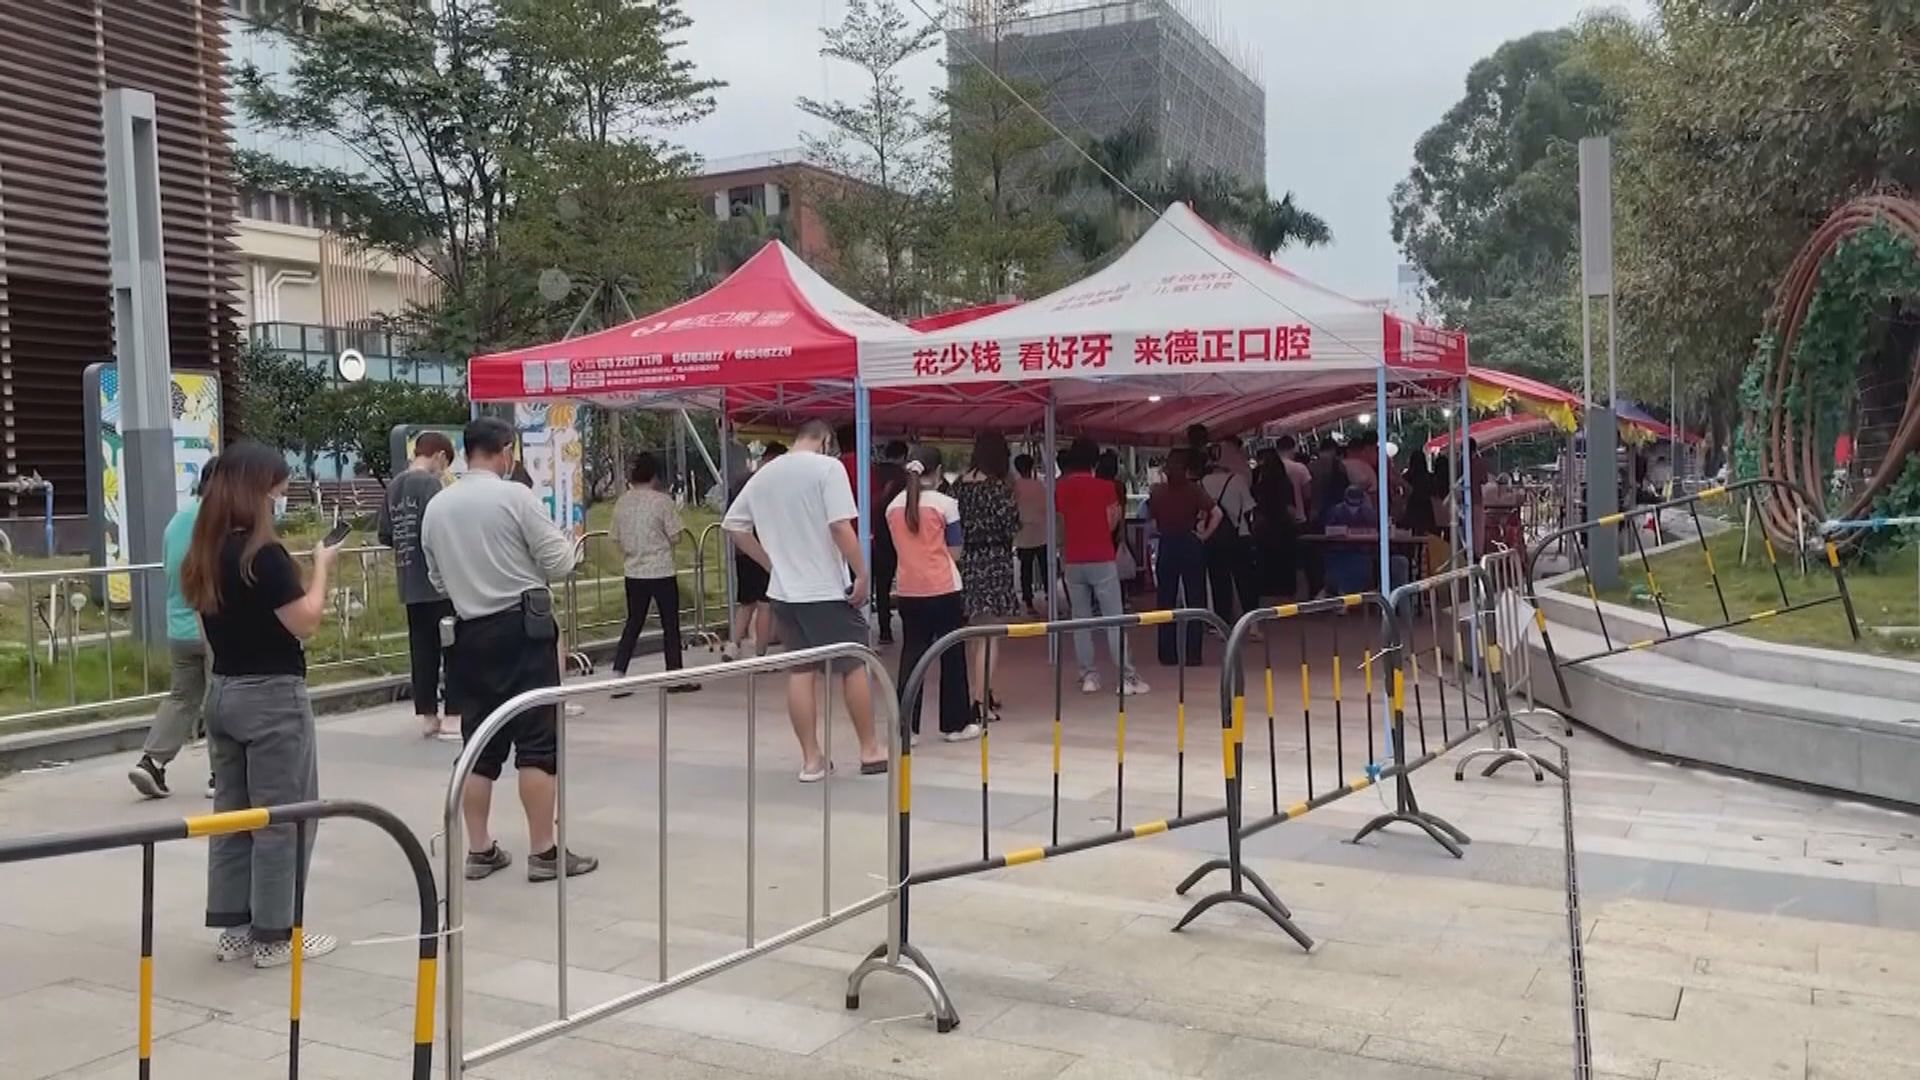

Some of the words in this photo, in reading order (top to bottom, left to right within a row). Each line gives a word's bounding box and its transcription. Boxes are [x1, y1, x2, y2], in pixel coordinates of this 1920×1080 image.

[913, 341, 1001, 376] 花少钱
[1018, 334, 1113, 371] 看好牙
[1134, 325, 1311, 365] 来德正口腔
